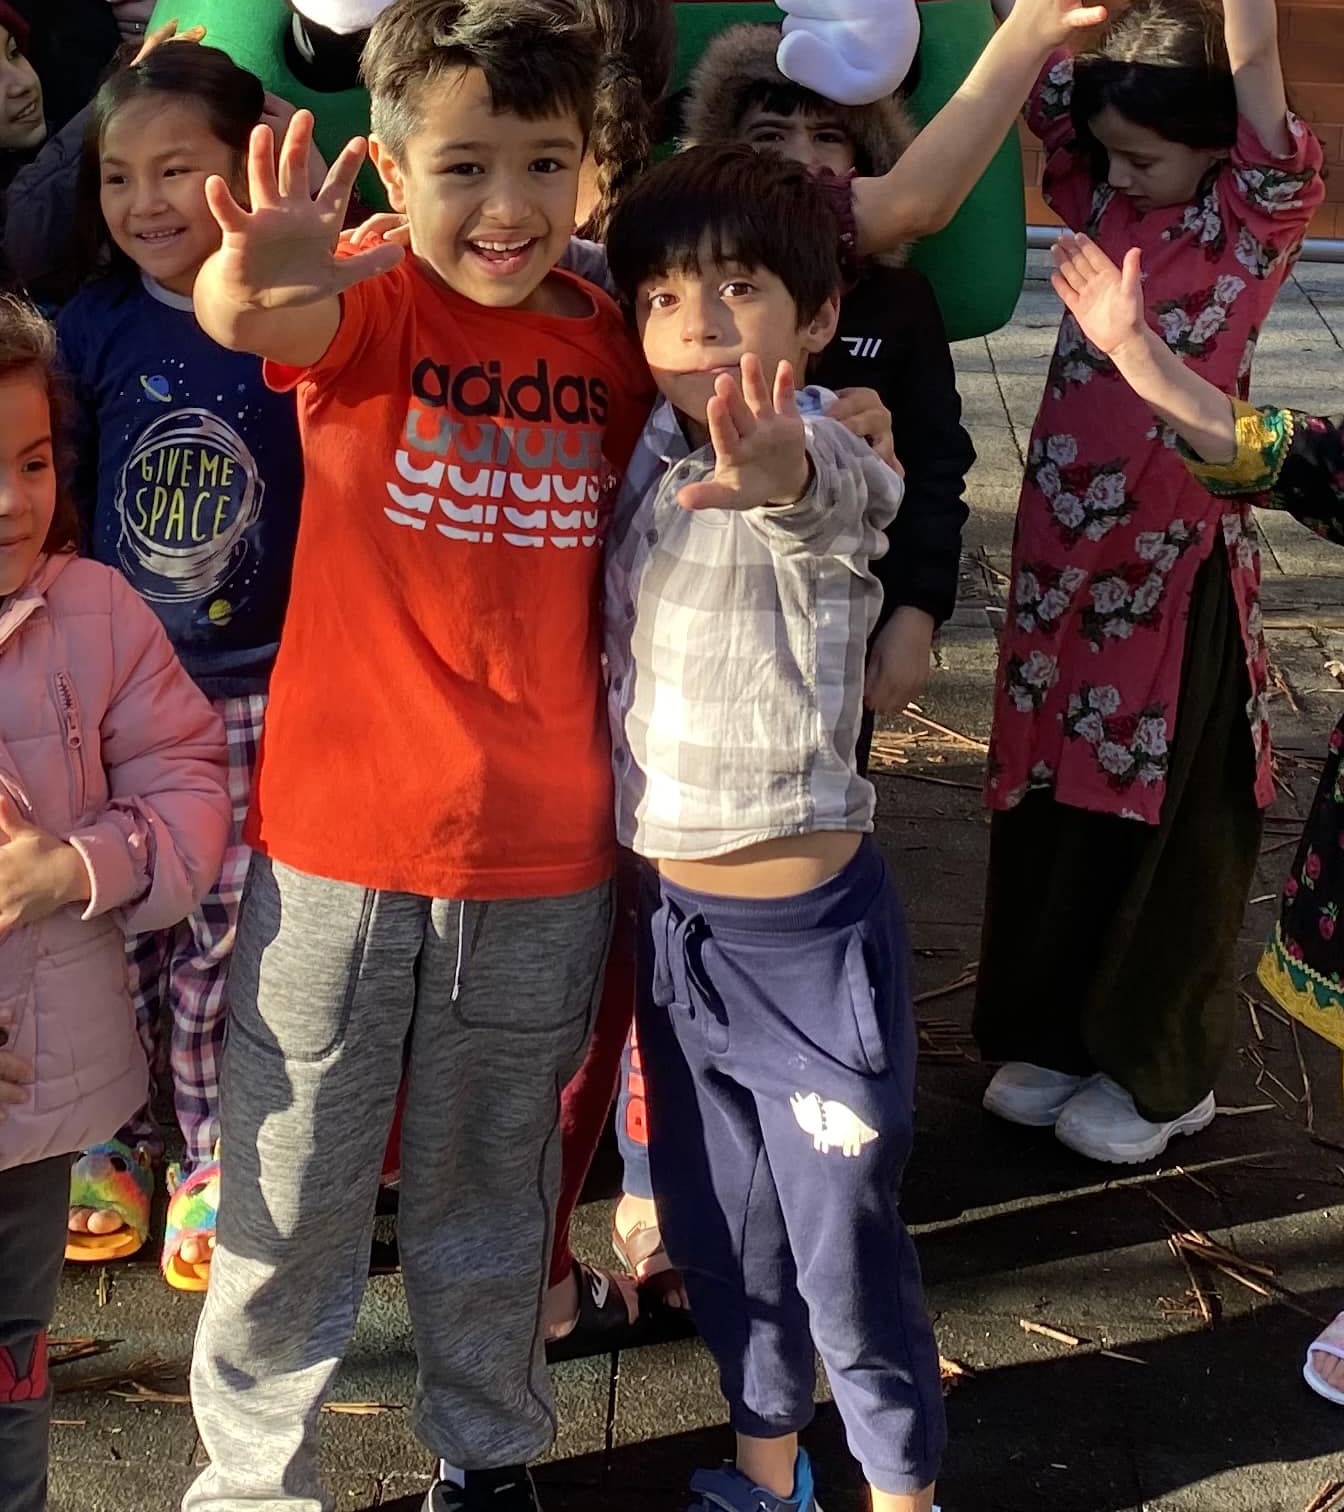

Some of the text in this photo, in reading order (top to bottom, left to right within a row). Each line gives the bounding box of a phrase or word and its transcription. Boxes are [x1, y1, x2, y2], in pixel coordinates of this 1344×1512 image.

[411, 357, 609, 426] adidas
[141, 447, 236, 488] GIVE ME
[135, 486, 232, 541] SPACE
